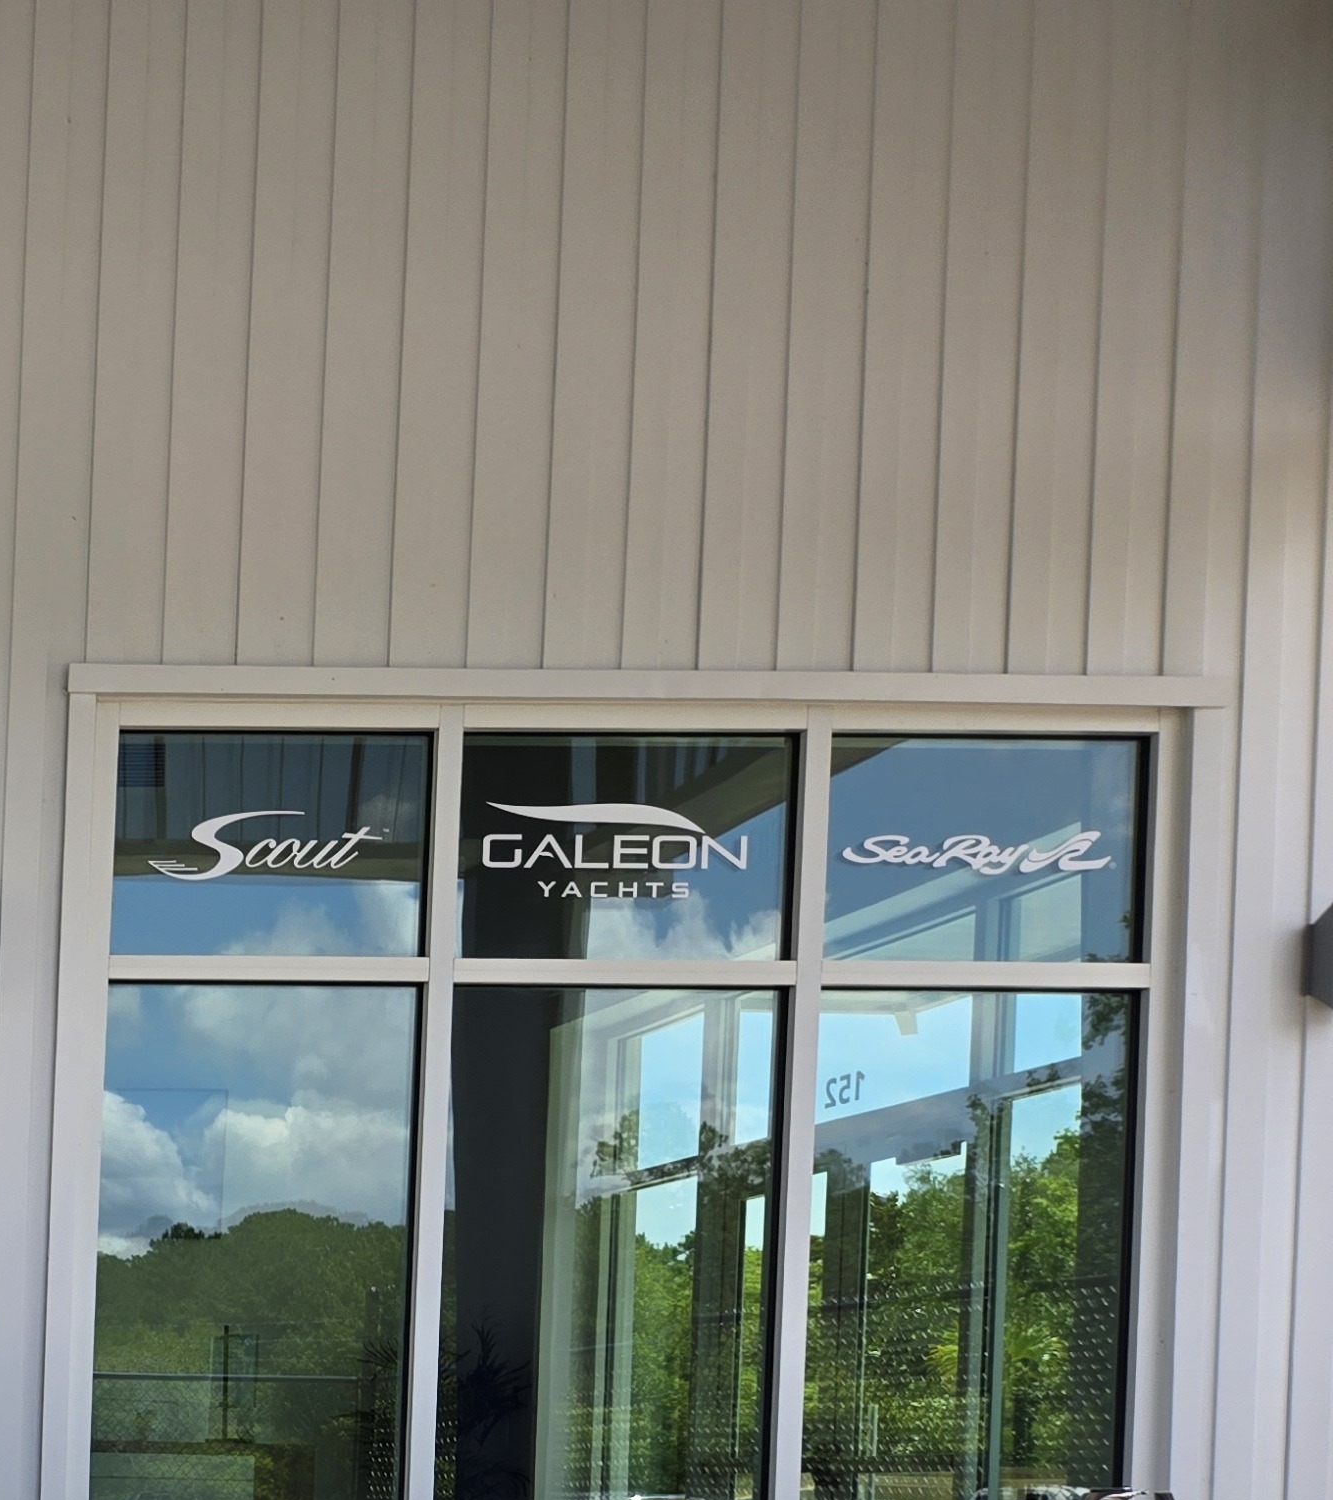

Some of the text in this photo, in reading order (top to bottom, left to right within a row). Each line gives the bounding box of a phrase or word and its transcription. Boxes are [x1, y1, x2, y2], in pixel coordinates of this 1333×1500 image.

[148, 810, 383, 881] Scout
[482, 833, 748, 870] GALEON
[842, 834, 1025, 875] Sea Ray
[538, 880, 690, 899] YACHTS
